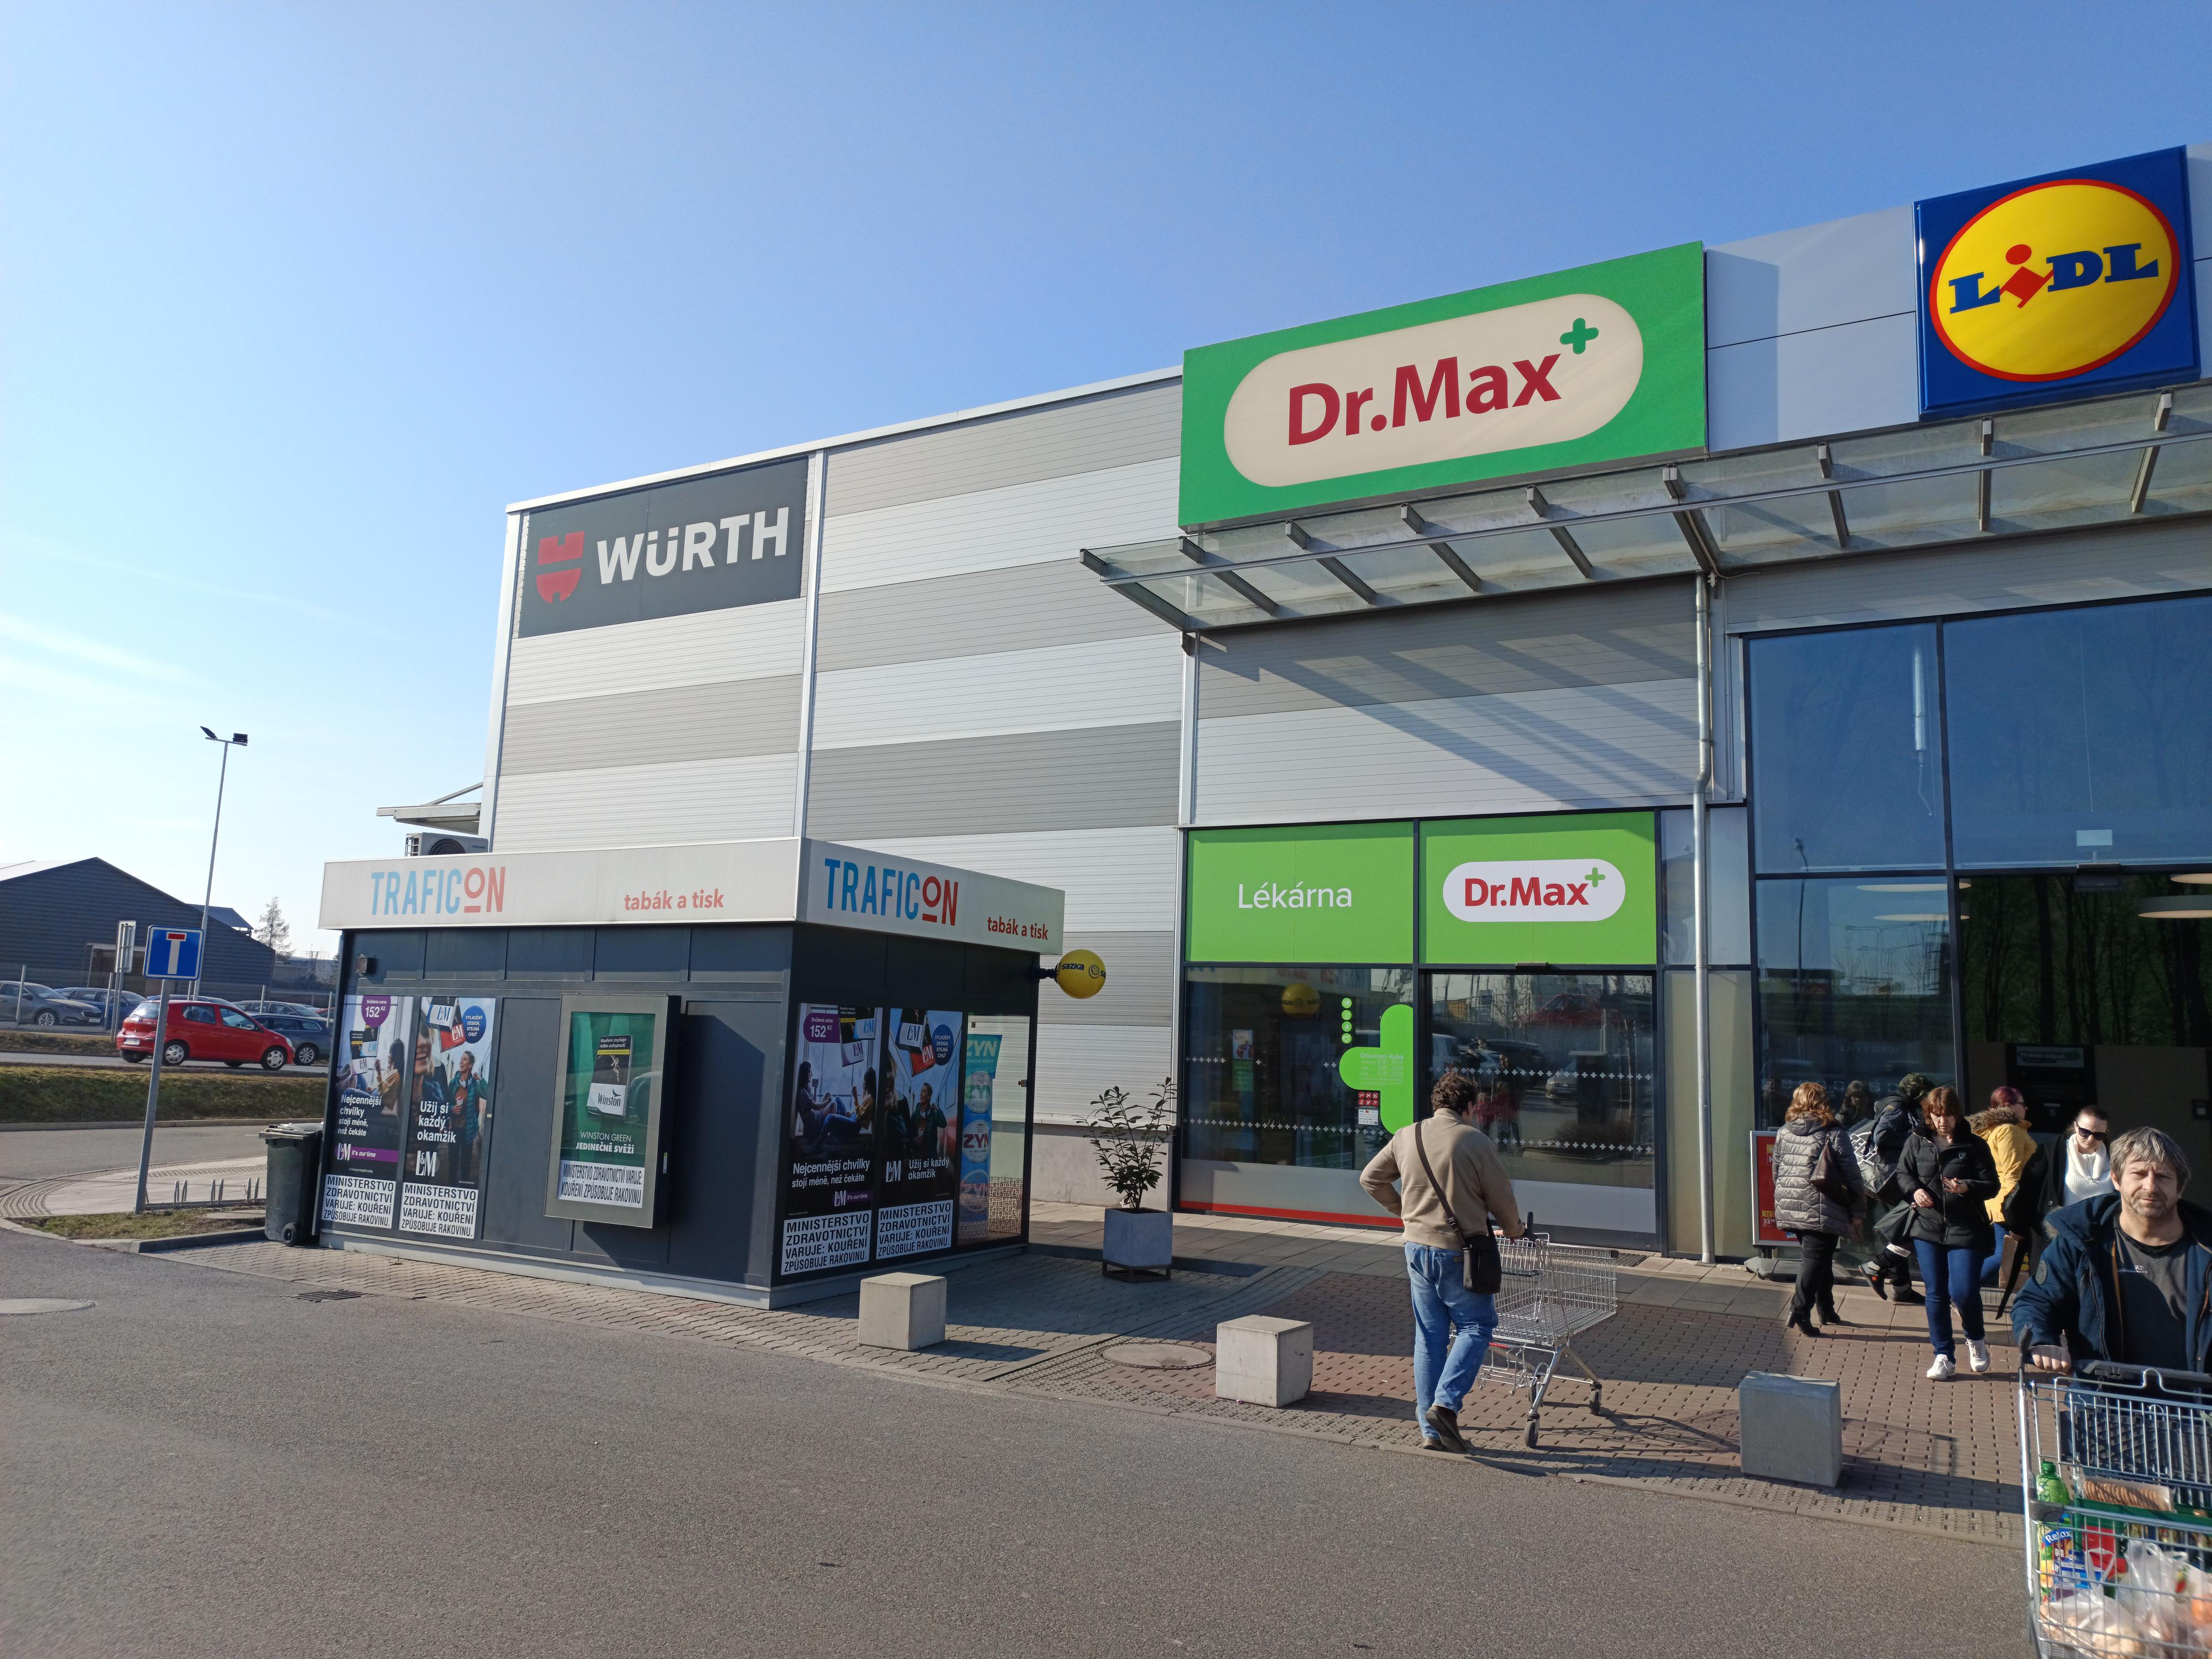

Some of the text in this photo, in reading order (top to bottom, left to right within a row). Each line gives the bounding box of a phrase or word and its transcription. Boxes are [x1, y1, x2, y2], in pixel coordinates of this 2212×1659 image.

[597, 507, 789, 585] WÜRTH
[371, 867, 505, 915] TRAFICON
[825, 858, 958, 926] TRAFICON
[1238, 881, 1353, 909] Lékárna
[624, 889, 724, 911] tabák a tisk
[987, 916, 1048, 940] tabák a tisk
[365, 1006, 380, 1018] 152
[437, 1006, 450, 1021] L&M
[452, 1024, 463, 1041] L&M
[810, 1025, 826, 1037] 152
[907, 1025, 920, 1041] L&M
[922, 1045, 933, 1063] L&M
[967, 1040, 998, 1056] ZYN
[341, 1094, 382, 1107] Nejcennější
[420, 1100, 449, 1116] Užij si
[598, 1093, 621, 1107] Winston
[340, 1106, 364, 1118] chvilky
[338, 1118, 368, 1127] stojí méně,
[418, 1115, 446, 1131] každý
[348, 1128, 367, 1136] čekáte
[417, 1129, 457, 1143] okamžik
[581, 1131, 631, 1142] WINSTON GREEN
[337, 1142, 351, 1161] L&M
[576, 1142, 634, 1154] JEDINEČNĚ SVĚŽÍ
[415, 1150, 437, 1177] L&M
[793, 1159, 870, 1176] Nejcennější chvilky
[885, 1160, 901, 1182] L&M
[909, 1157, 950, 1170] Užij si každý
[563, 1164, 643, 1185] MINISTERSTVO ZDRAVOTNICTVÍ VARUJE:
[792, 1173, 864, 1189] stojí méně, než čekáte
[908, 1168, 936, 1180] okamžik
[327, 1176, 394, 1192] MINISTERSTVO
[405, 1184, 476, 1201] MINISTERSTVO
[561, 1181, 641, 1204] KOUŘENÍ ZPŮSOBUJE RAKOVINU
[326, 1187, 393, 1203] ZDRAVOTNICTVÍ
[834, 1190, 847, 1207] L&M
[326, 1198, 392, 1215] VARUJE: KOUŘENÍ
[404, 1196, 476, 1213] ZDRAVOTNICTVÍ
[880, 1202, 951, 1220] MINISTERSTVO
[358, 1214, 390, 1227] RAKOVINU.
[403, 1207, 474, 1224] VARUJE: KOUŘENÍ
[787, 1213, 869, 1233] MINISTERSTVO
[879, 1212, 951, 1233] ZDRAVOTNICTVÍ
[401, 1218, 472, 1237] ZPŮSOBUJE RAKOVINU.
[786, 1223, 869, 1246] ZDRAVOTNICTVÍ
[879, 1223, 950, 1245] VARUJE: KOUŘENÍ
[785, 1235, 868, 1259] VARUJE: KOUŘENÍ
[917, 1237, 949, 1250] RAKOVINU.
[784, 1250, 867, 1272] ZPŮSOBUJE RAKOVINU.
[2045, 1530, 2072, 1543] Relax
